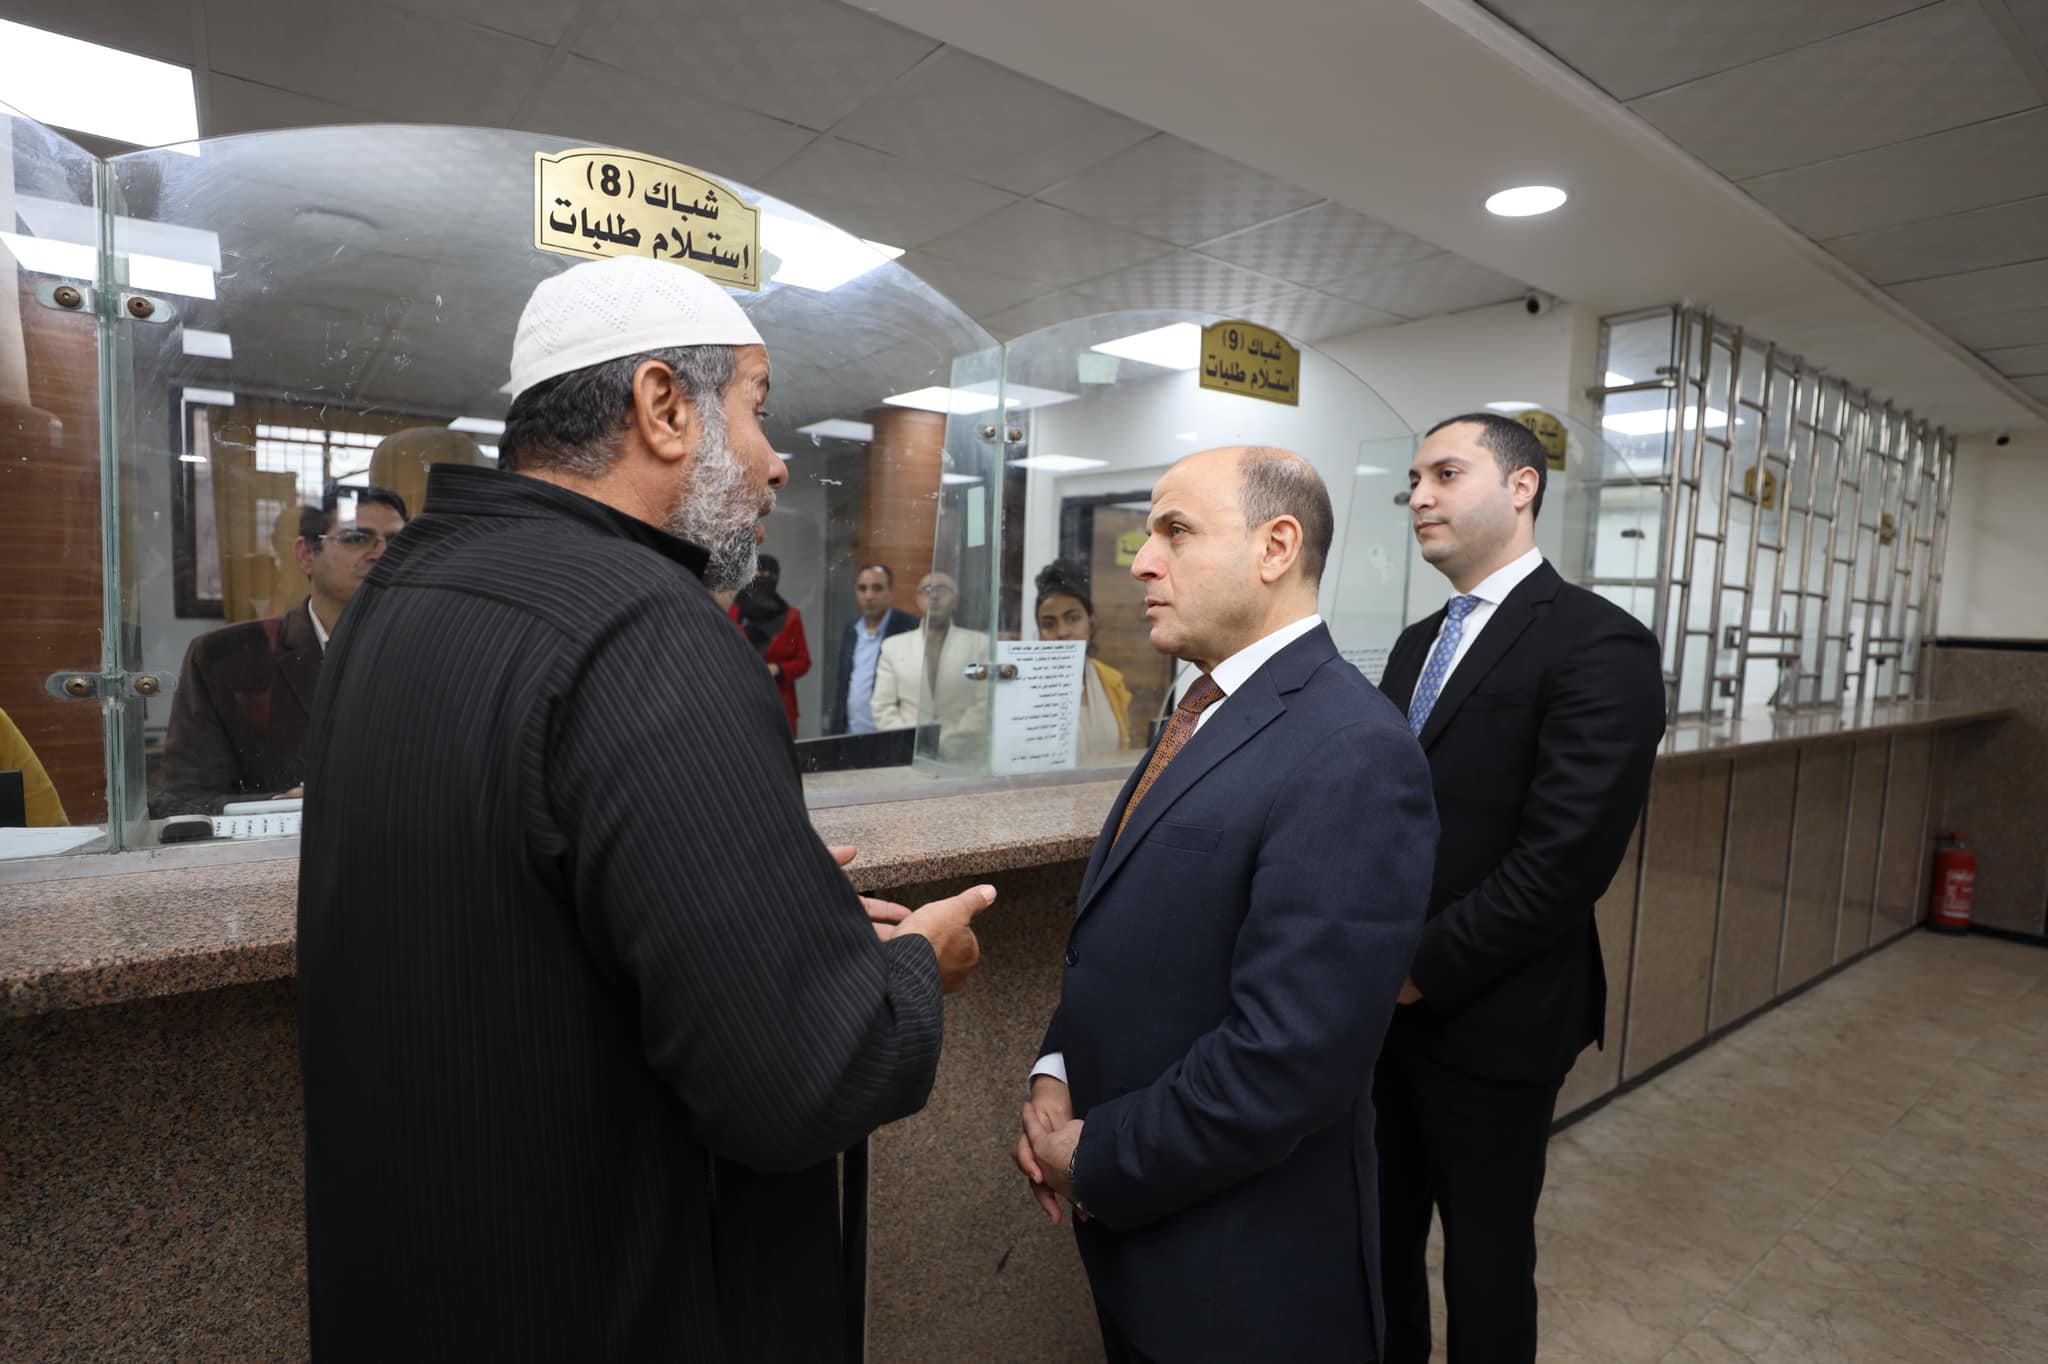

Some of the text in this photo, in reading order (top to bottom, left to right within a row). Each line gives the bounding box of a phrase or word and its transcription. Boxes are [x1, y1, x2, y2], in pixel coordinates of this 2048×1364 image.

[586, 161, 719, 221] شباك (8)
[550, 197, 749, 280] إستلام طلبات
[1222, 328, 1281, 364] شباك (9)
[1206, 355, 1246, 386] طلبات
